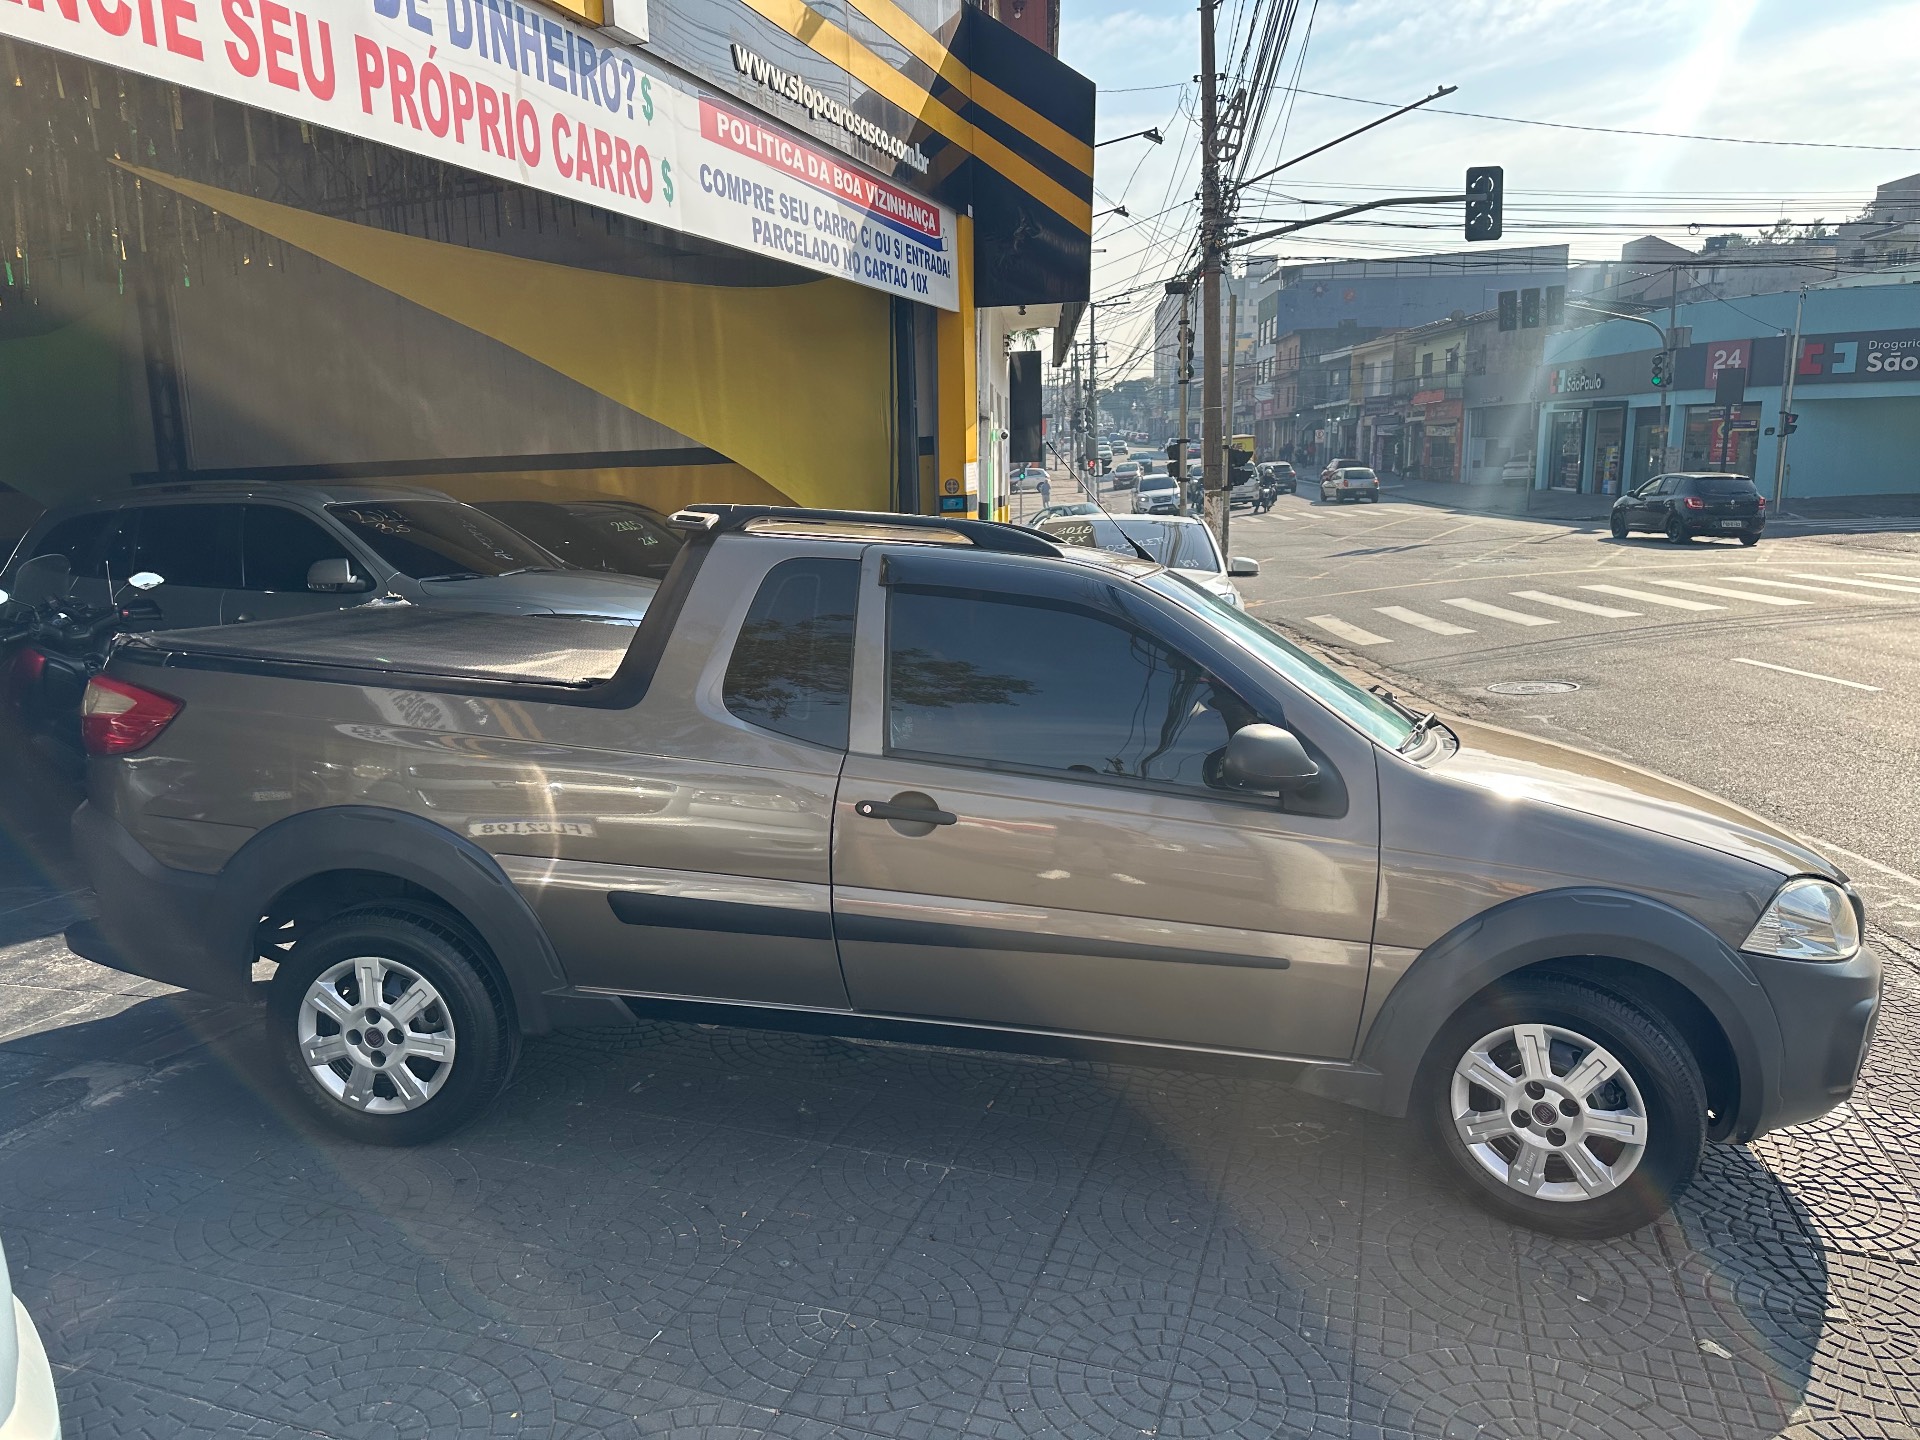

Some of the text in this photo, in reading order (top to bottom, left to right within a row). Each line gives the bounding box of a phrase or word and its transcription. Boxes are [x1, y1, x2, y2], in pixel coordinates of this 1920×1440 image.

[222, 0, 335, 101] SEU
[354, 34, 541, 168] PRÓPRIO
[552, 112, 653, 203] CARRO
[661, 156, 674, 207] $
[446, 0, 635, 120] DINHEIRO?
[641, 74, 654, 126] $
[700, 164, 775, 214] COMPRE
[779, 193, 809, 225] SEU
[814, 206, 857, 243] CARRO
[875, 231, 890, 255] OU
[906, 244, 951, 278] ENTRADA!
[716, 112, 936, 231] POLÍTICA DA BOA VIZINHANÇA
[752, 217, 839, 267] PARCELADO
[843, 247, 860, 274] NO
[911, 271, 928, 294] 10X
[1713, 349, 1742, 369] 24
[1866, 352, 1919, 372] São
